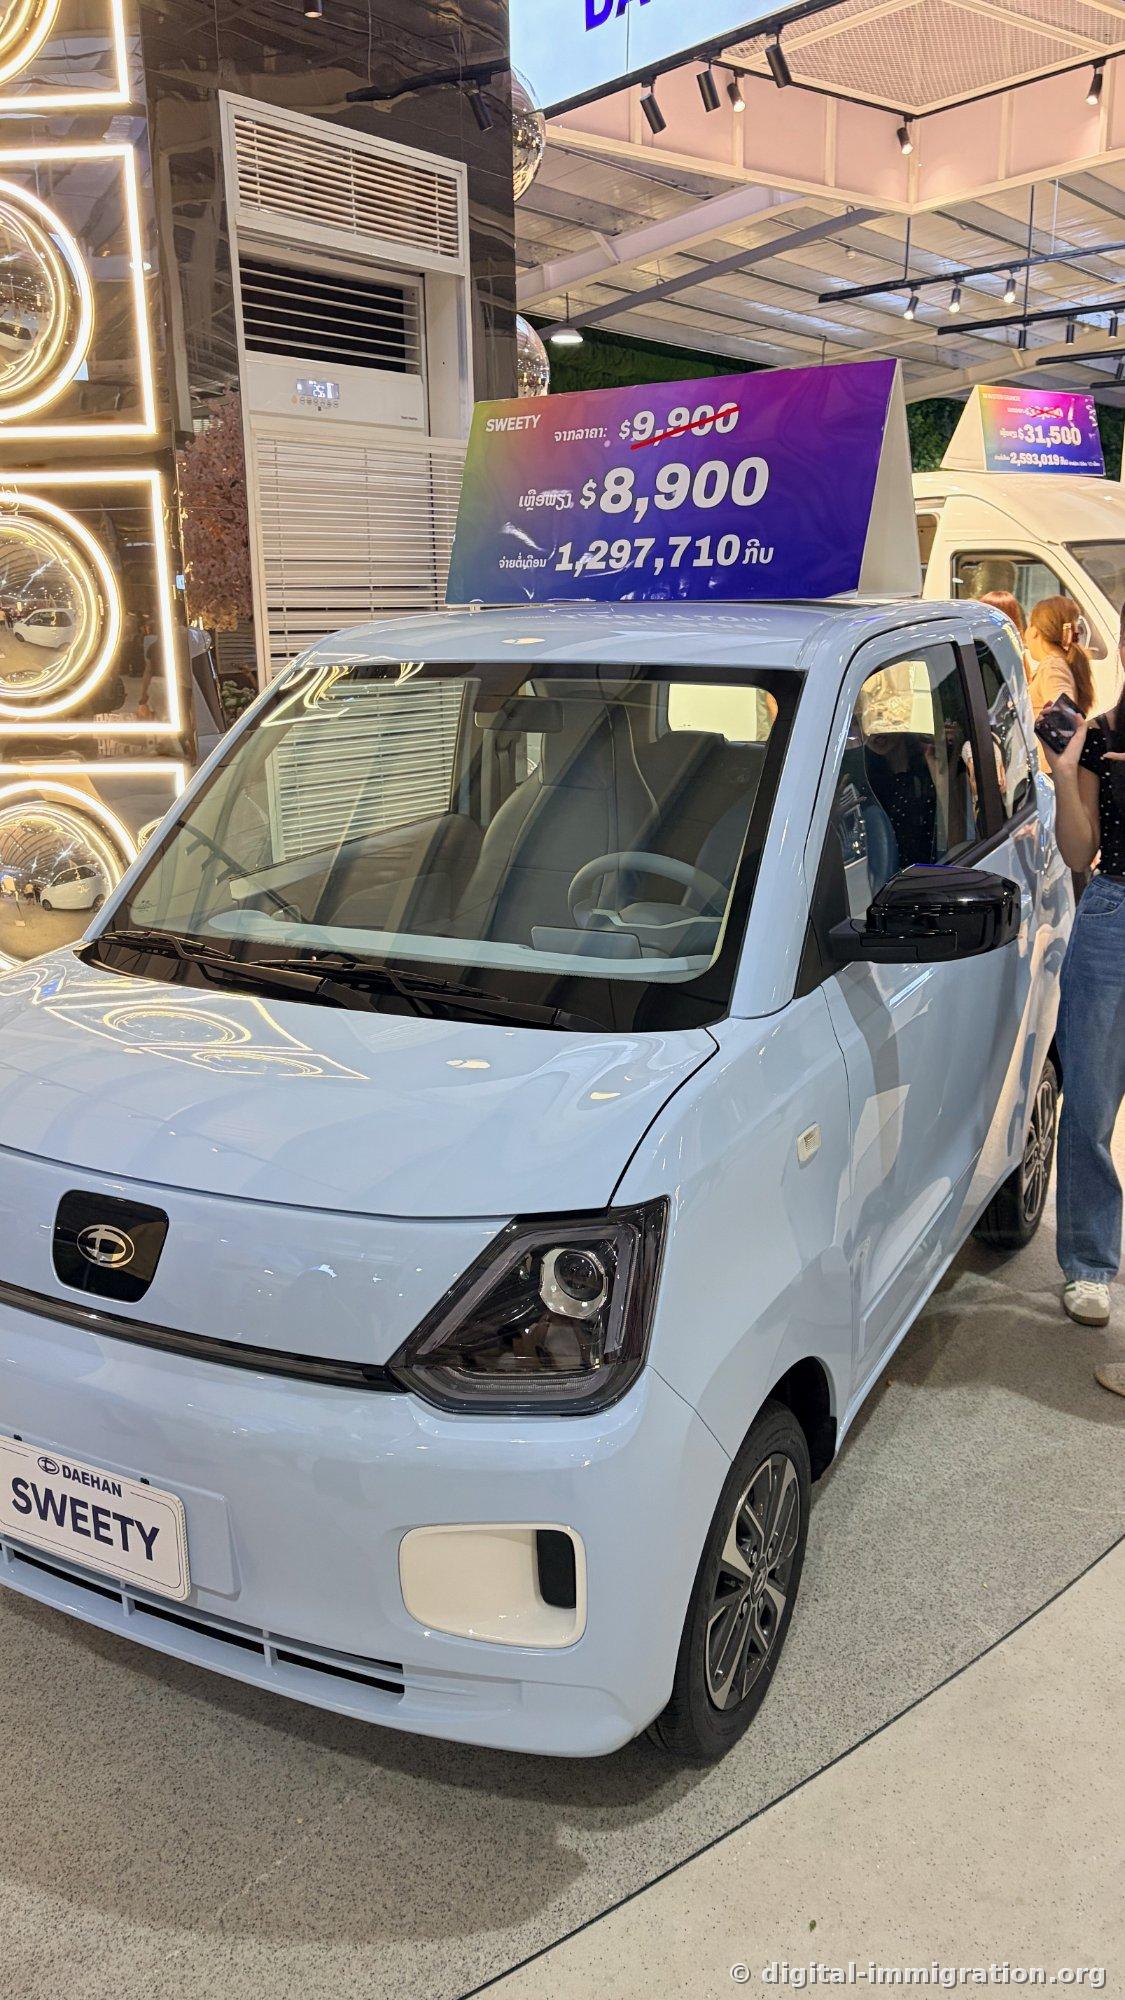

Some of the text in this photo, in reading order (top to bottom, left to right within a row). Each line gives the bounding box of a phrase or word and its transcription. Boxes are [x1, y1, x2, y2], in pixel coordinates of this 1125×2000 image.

[485, 414, 541, 432] SWEETY
[580, 457, 769, 523] $8,900
[62, 1464, 122, 1498] DAEHAN
[12, 1477, 160, 1561] SWEETY
